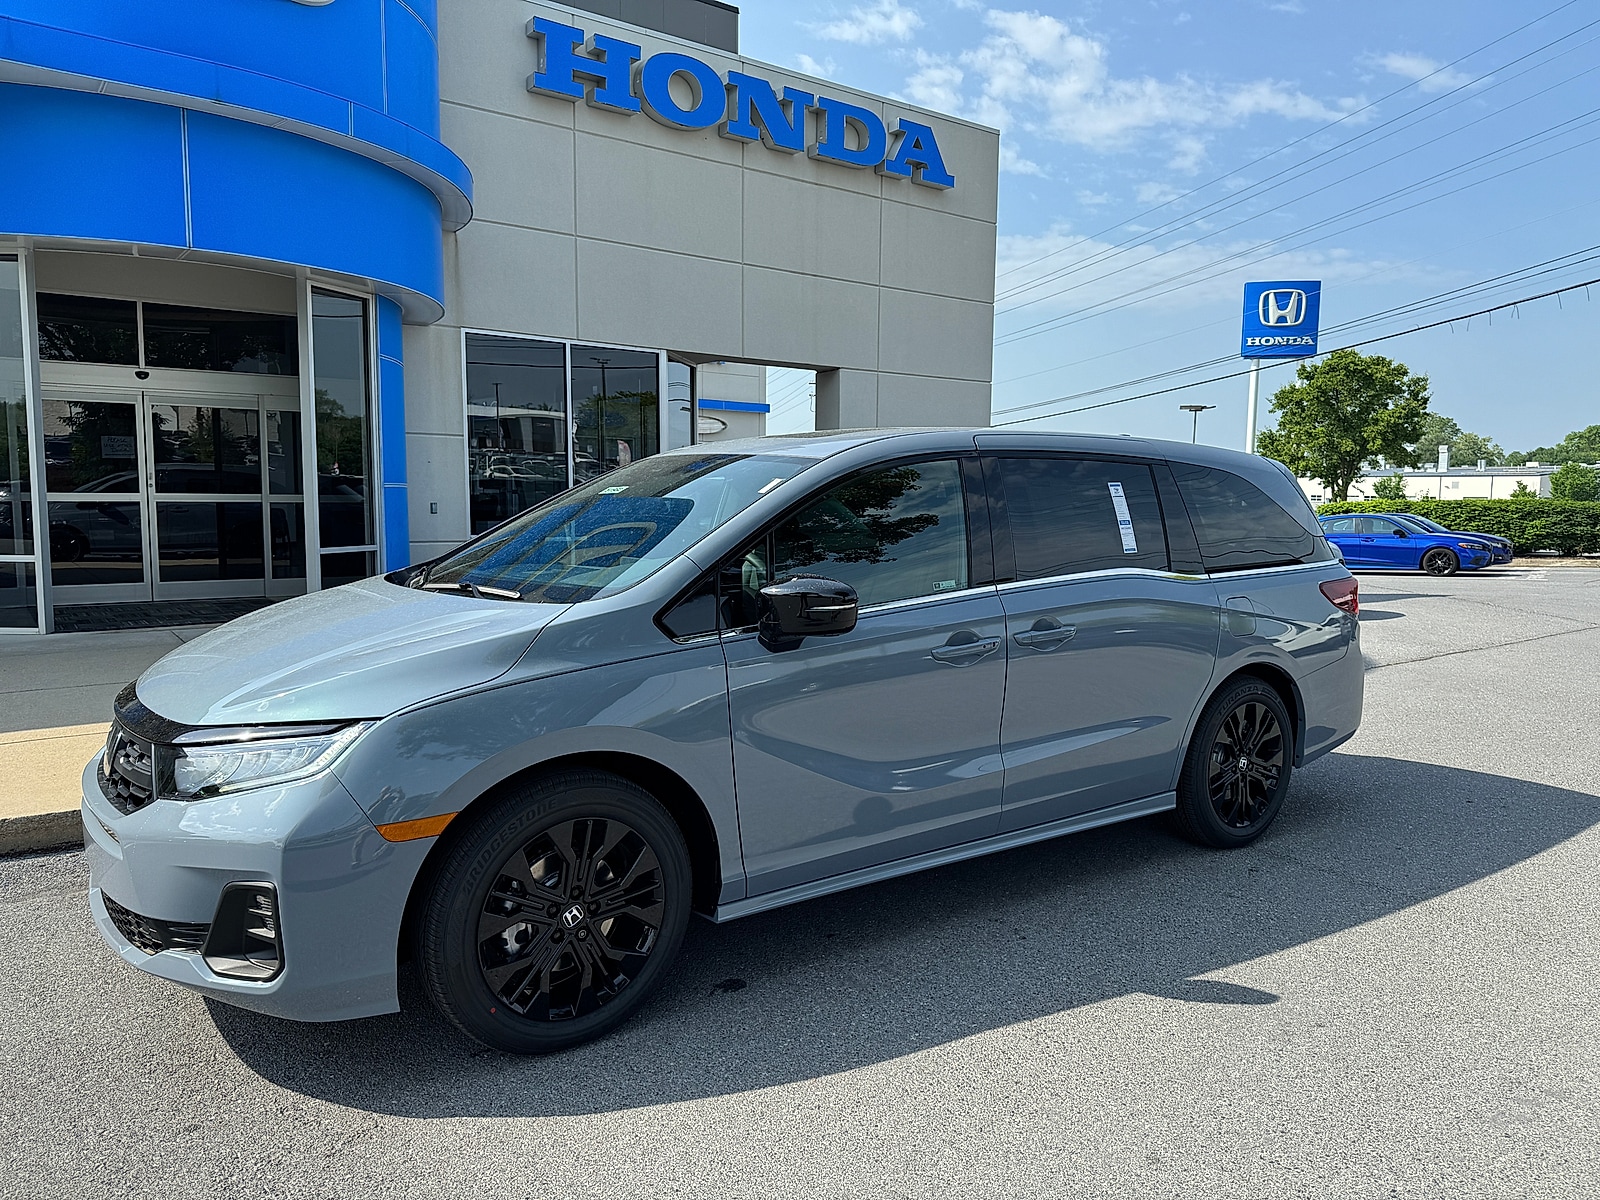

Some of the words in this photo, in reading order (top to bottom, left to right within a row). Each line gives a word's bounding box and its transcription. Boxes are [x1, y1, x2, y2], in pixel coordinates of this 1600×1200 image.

[527, 16, 955, 190] HONDA
[1246, 336, 1315, 346] HONDA
[1217, 685, 1259, 716] TURANZA
[462, 799, 557, 896] BRIDGESTONE
